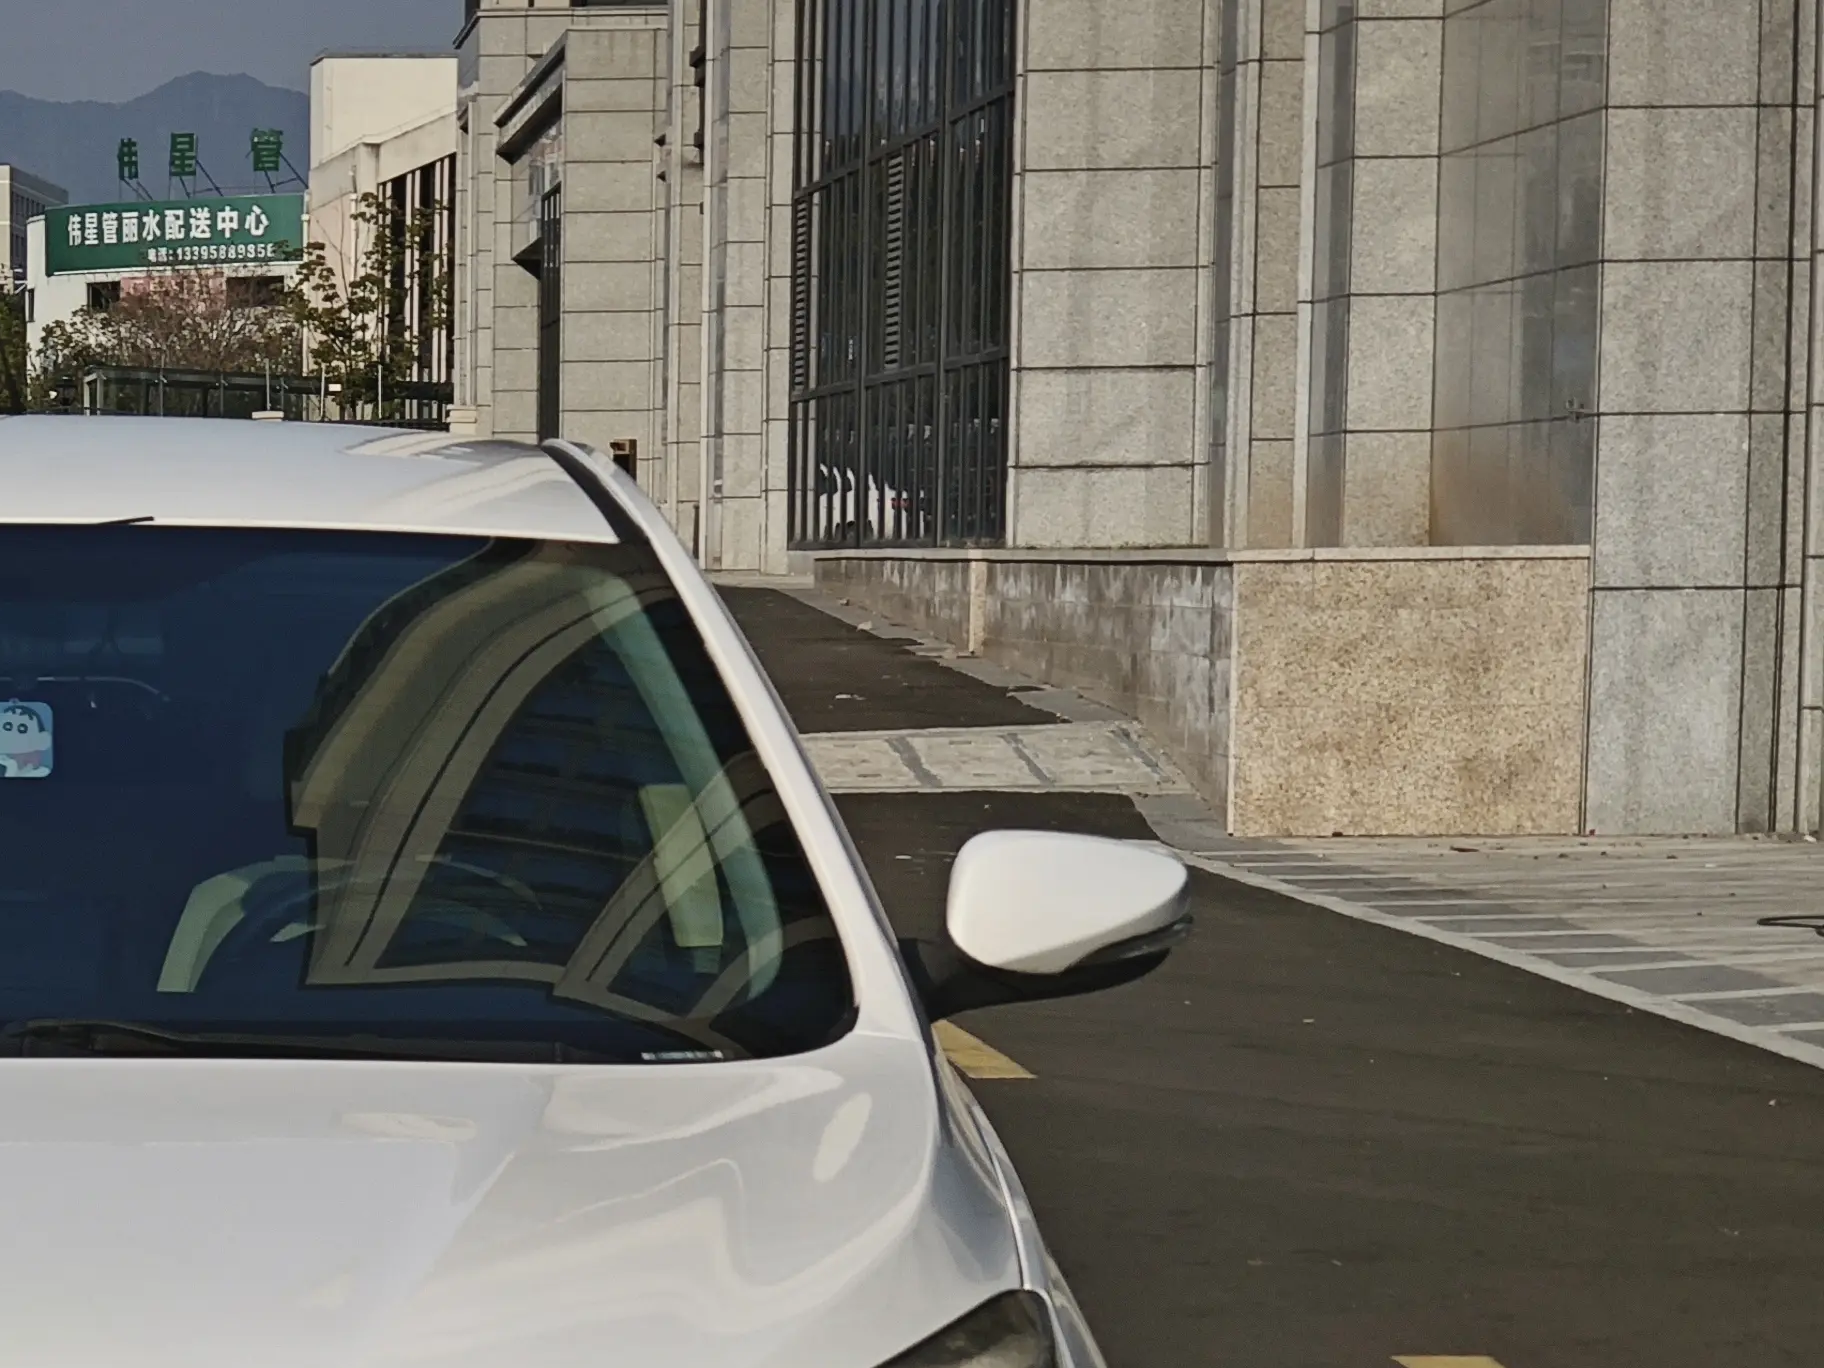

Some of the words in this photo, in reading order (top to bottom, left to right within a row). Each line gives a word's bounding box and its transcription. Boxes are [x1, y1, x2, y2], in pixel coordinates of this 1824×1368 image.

[117, 128, 283, 180] 伟星管
[68, 205, 269, 247] 伟星管丽水配送中心
